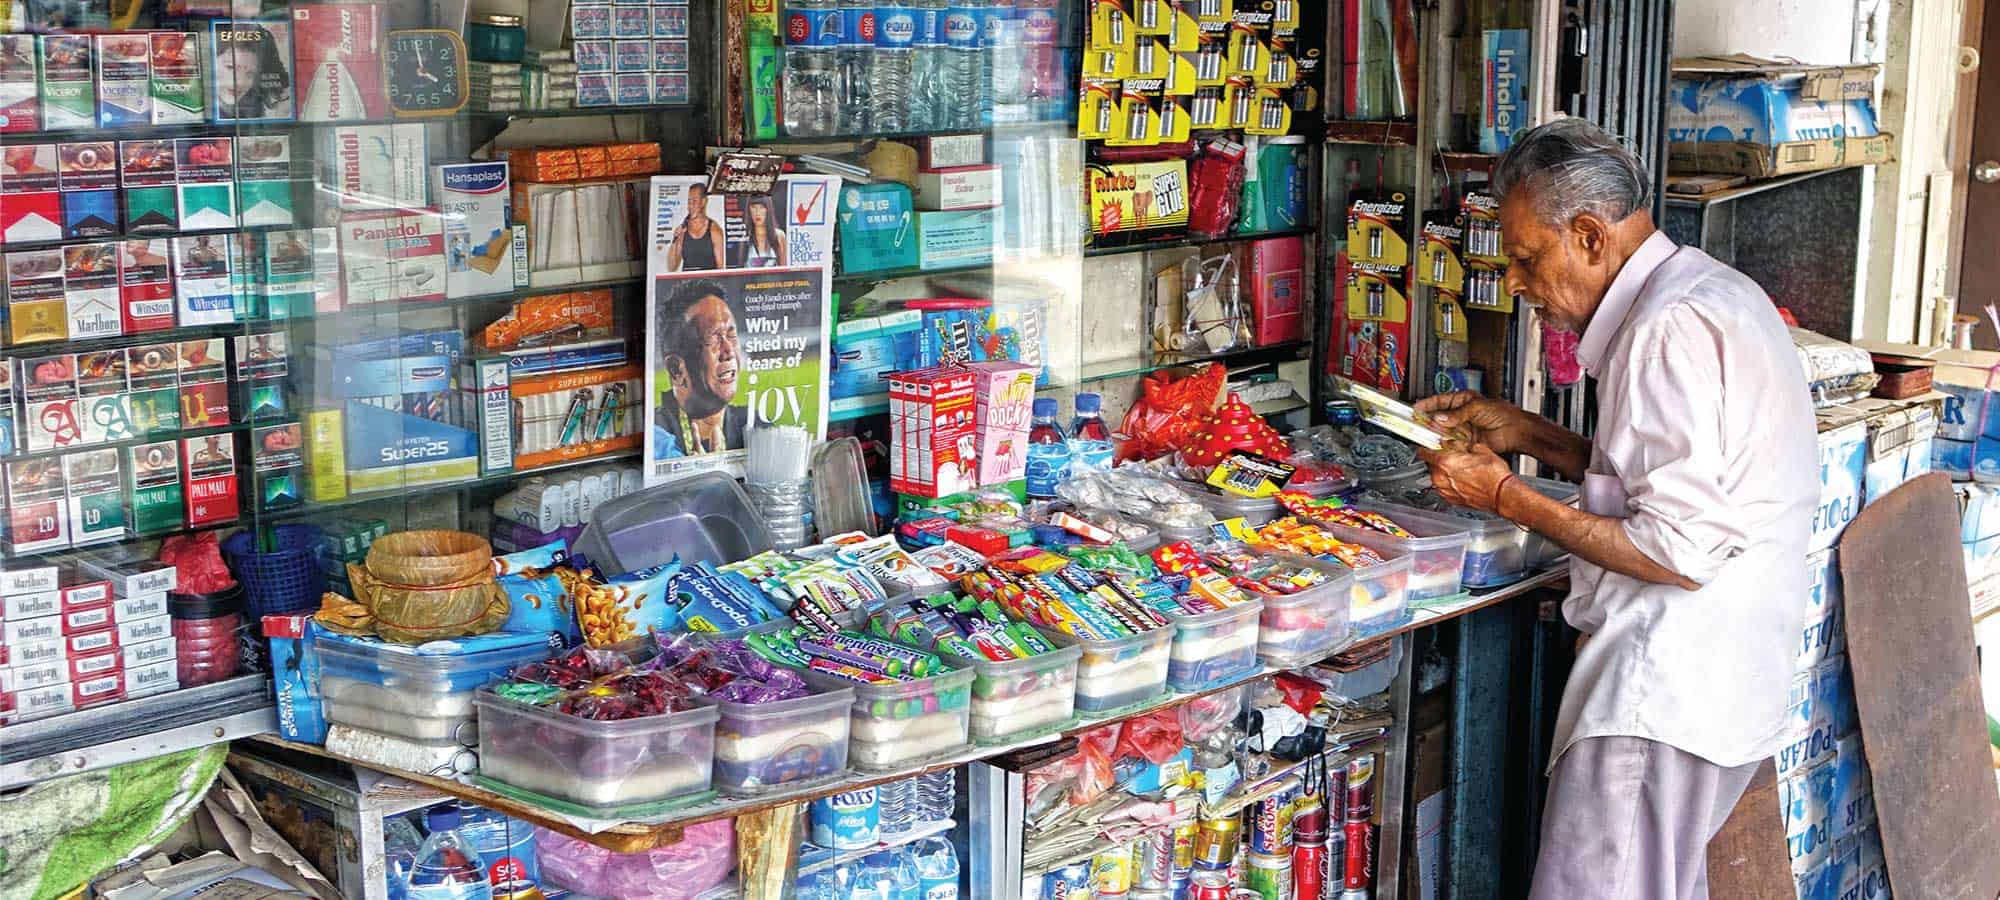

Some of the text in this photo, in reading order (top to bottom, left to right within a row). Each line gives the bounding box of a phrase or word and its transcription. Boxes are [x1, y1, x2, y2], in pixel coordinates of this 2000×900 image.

[1232, 9, 1272, 25] Energizer
[440, 48, 449, 60] 2
[1496, 48, 1517, 137] Inhaler
[447, 170, 503, 184] Hansaplast
[1353, 200, 1404, 221] Energizer
[353, 223, 421, 241] Panadol
[790, 229, 811, 240] the
[1424, 222, 1463, 240] Energizer
[790, 240, 815, 252] new
[790, 250, 823, 265] paper
[135, 301, 171, 315] Winston
[77, 313, 120, 333] Marlboro
[745, 315, 789, 335] Why I
[745, 335, 808, 353] shed my
[746, 352, 802, 371] tears of
[487, 391, 507, 403] AXE
[744, 372, 813, 432] joy
[989, 404, 1032, 427] POCKY
[381, 441, 449, 462] Super25
[17, 598, 53, 612] Marlboro
[126, 600, 159, 615] Marlboro
[17, 623, 53, 638] Marlboro
[130, 623, 163, 638] Marlboro
[23, 645, 57, 658] Marlboro
[136, 646, 168, 661] Marlboro
[137, 668, 169, 683] Marlboro
[30, 690, 64, 705] Marlboro
[1779, 724, 1833, 773] POLAR
[1264, 798, 1276, 850] SEASONS
